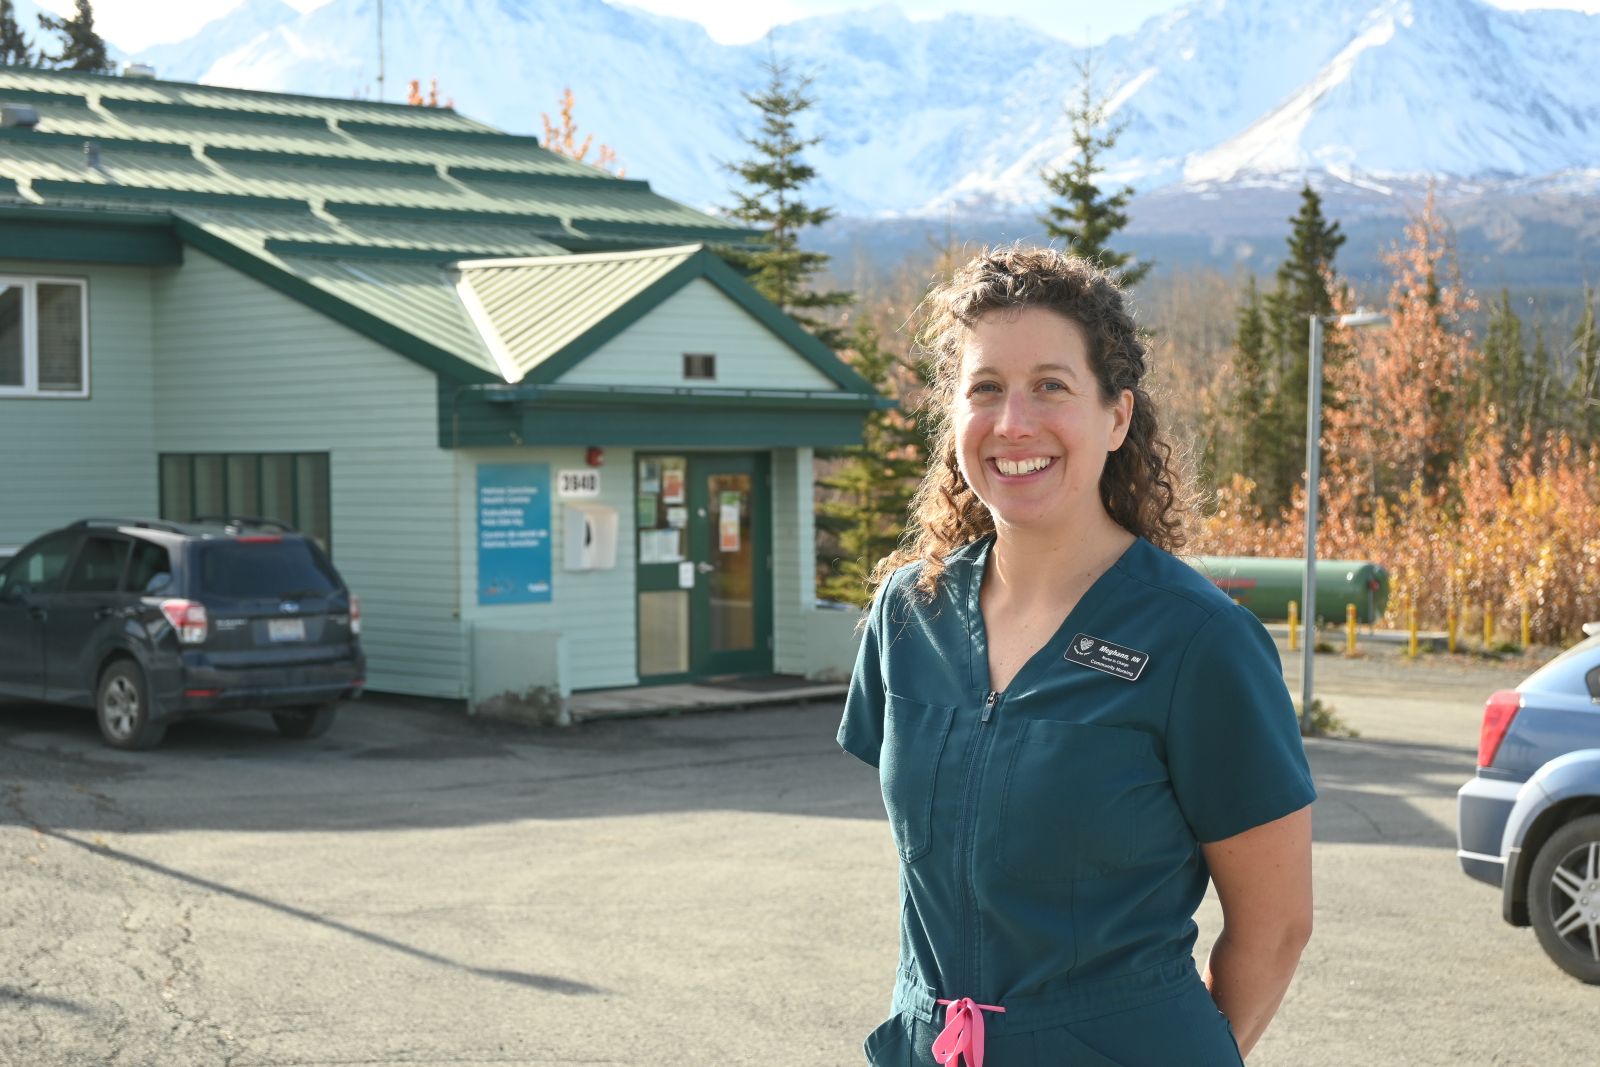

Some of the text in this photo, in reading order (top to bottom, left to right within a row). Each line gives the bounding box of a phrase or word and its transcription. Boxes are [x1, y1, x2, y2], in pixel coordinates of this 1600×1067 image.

[1099, 645, 1129, 660] Meghann,
[1090, 658, 1134, 677] Community Nursing
